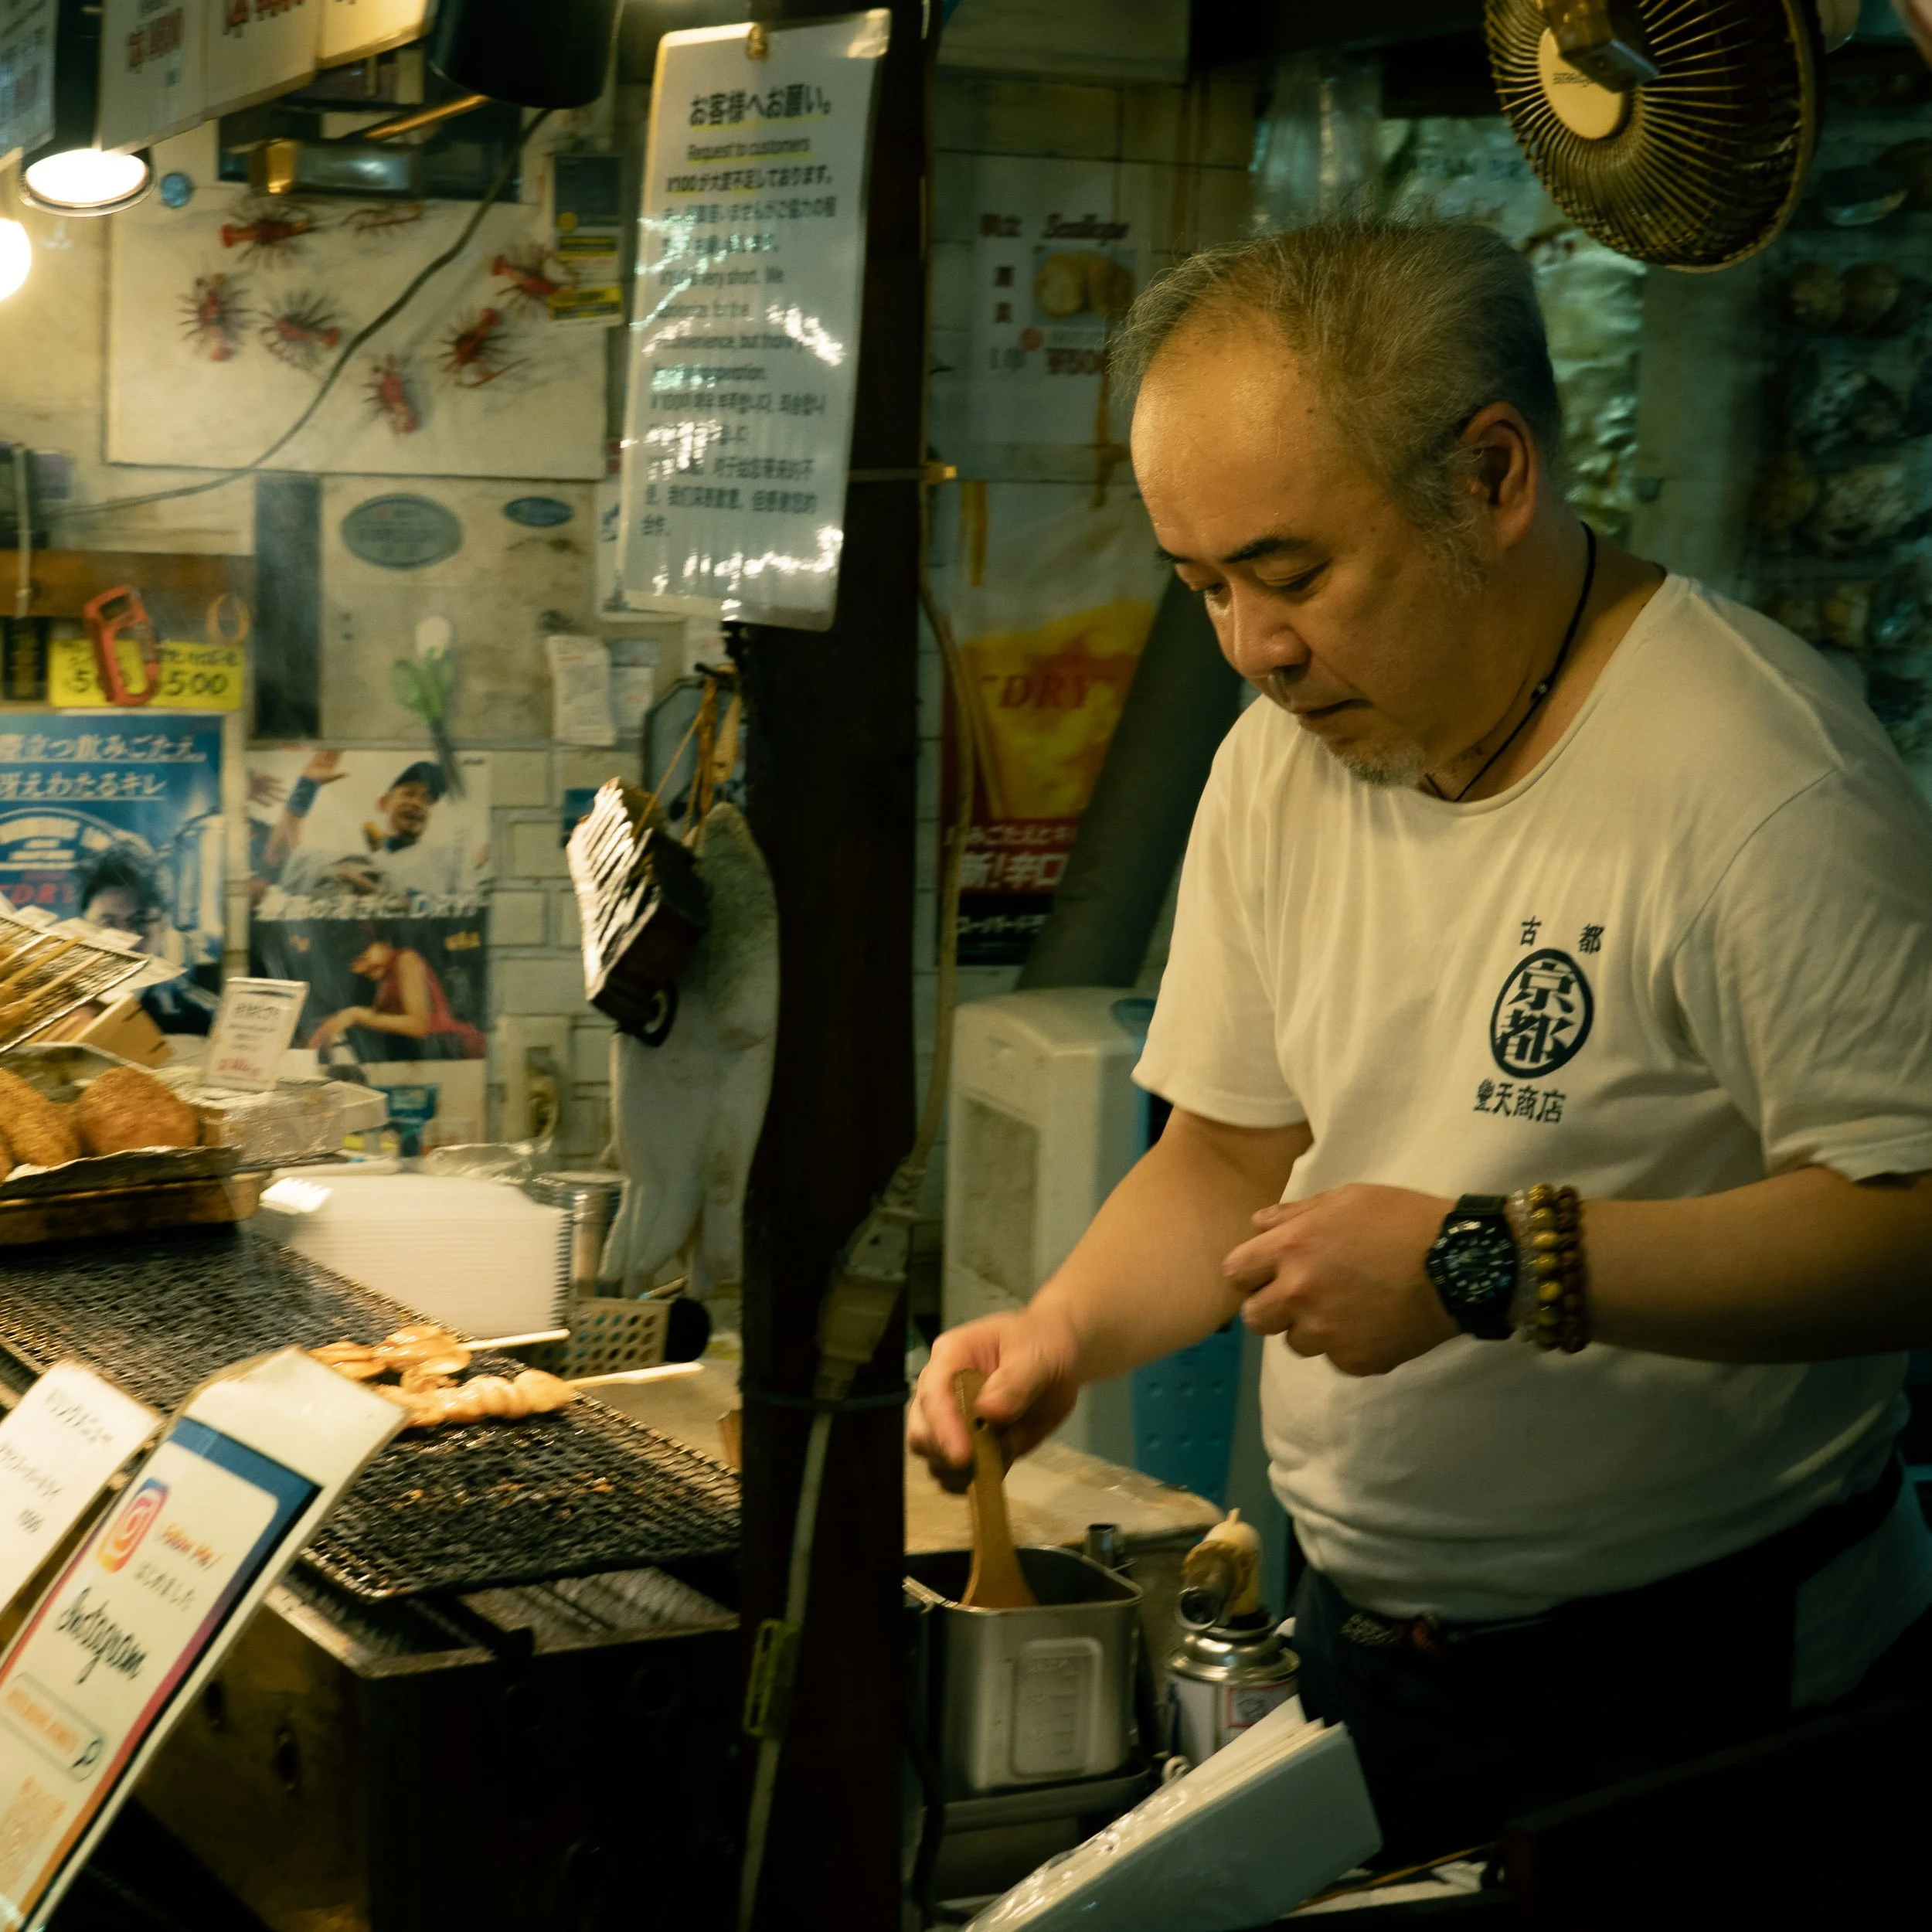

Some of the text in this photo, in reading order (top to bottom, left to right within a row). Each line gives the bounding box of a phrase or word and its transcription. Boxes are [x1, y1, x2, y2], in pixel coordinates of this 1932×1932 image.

[689, 83, 832, 127] お客様へお願い。
[687, 144, 733, 161] Request
[750, 138, 811, 156] customers
[1495, 961, 1577, 1064] 京都
[56, 1587, 147, 1685] Instagram
